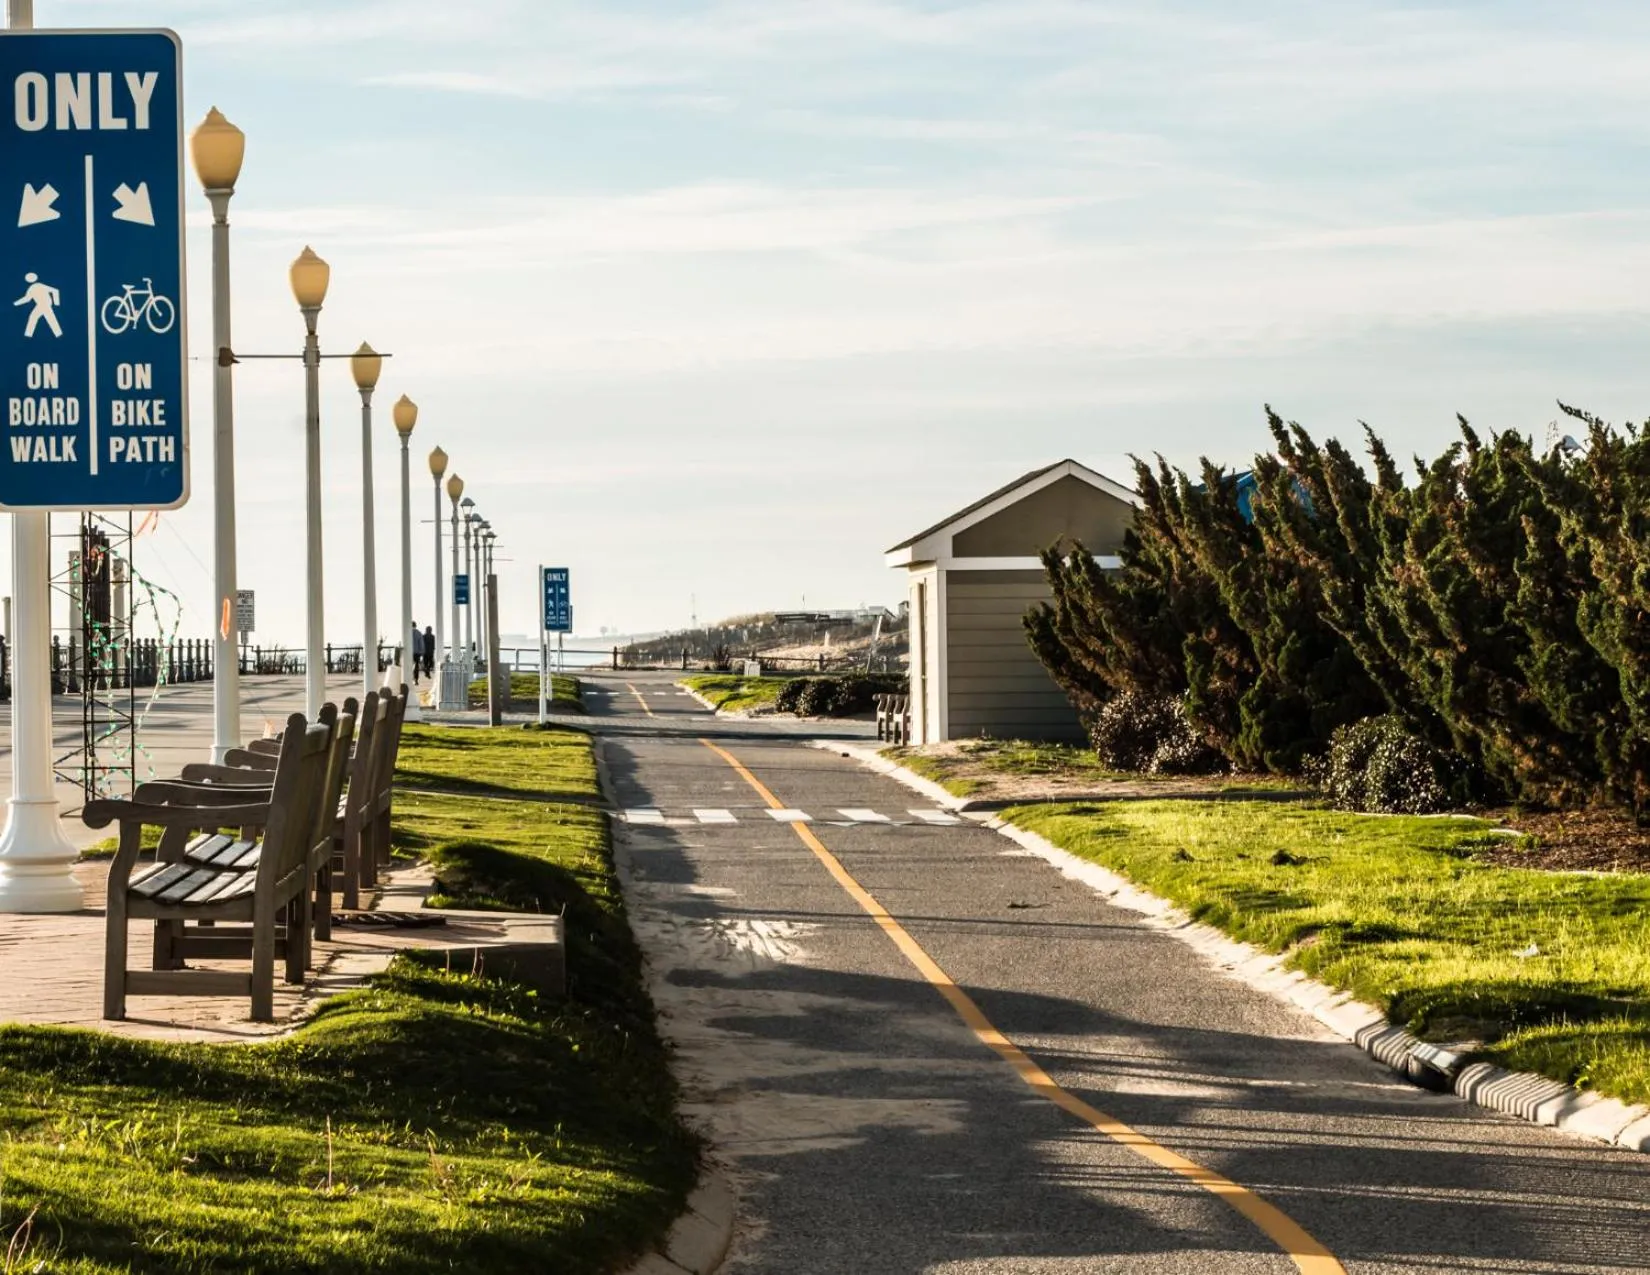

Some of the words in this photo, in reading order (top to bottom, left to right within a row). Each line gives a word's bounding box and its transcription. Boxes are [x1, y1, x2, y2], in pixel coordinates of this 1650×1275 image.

[14, 71, 159, 132] ONLY
[27, 362, 59, 390] ON
[117, 363, 152, 390] ON
[8, 397, 80, 426] BOARD
[111, 399, 166, 426] BIKE
[10, 435, 77, 463] WALK
[109, 436, 175, 463] PATH
[547, 572, 567, 582] ONLY
